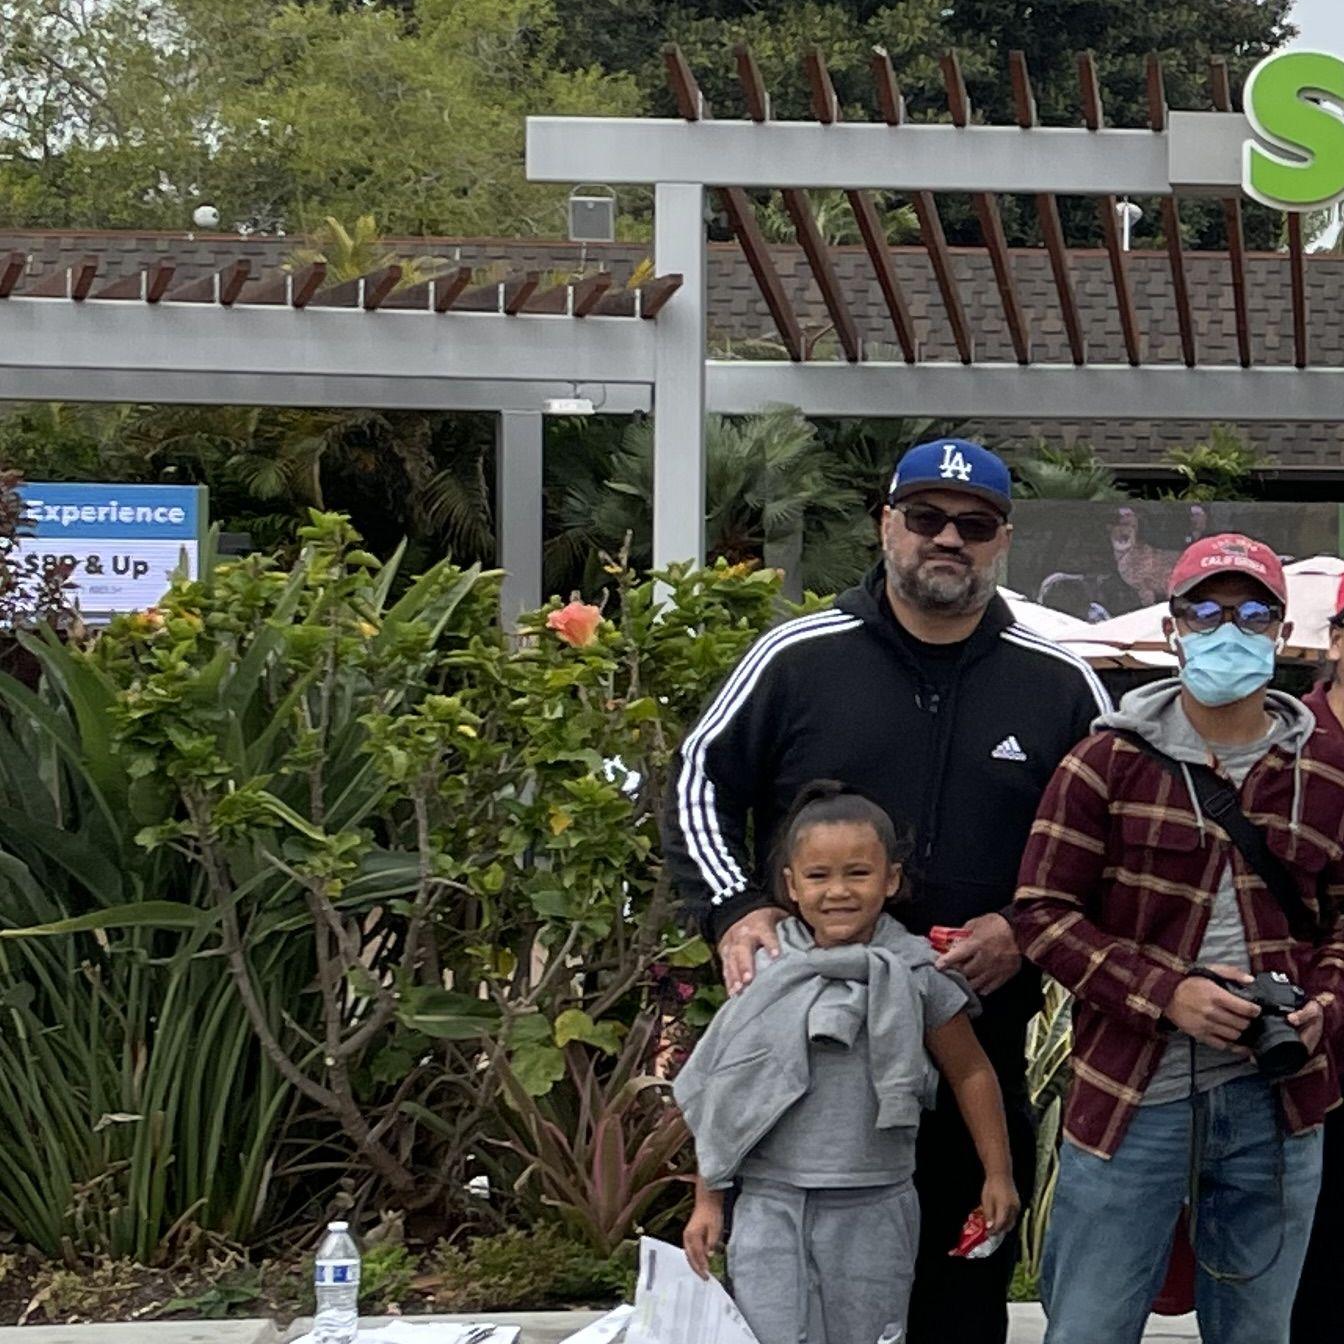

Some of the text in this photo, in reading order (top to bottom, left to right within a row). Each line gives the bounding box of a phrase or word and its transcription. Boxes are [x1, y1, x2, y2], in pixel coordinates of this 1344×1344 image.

[939, 444, 972, 481] LA
[26, 500, 186, 527] Experience
[85, 554, 104, 575] &
[112, 555, 149, 580] Up
